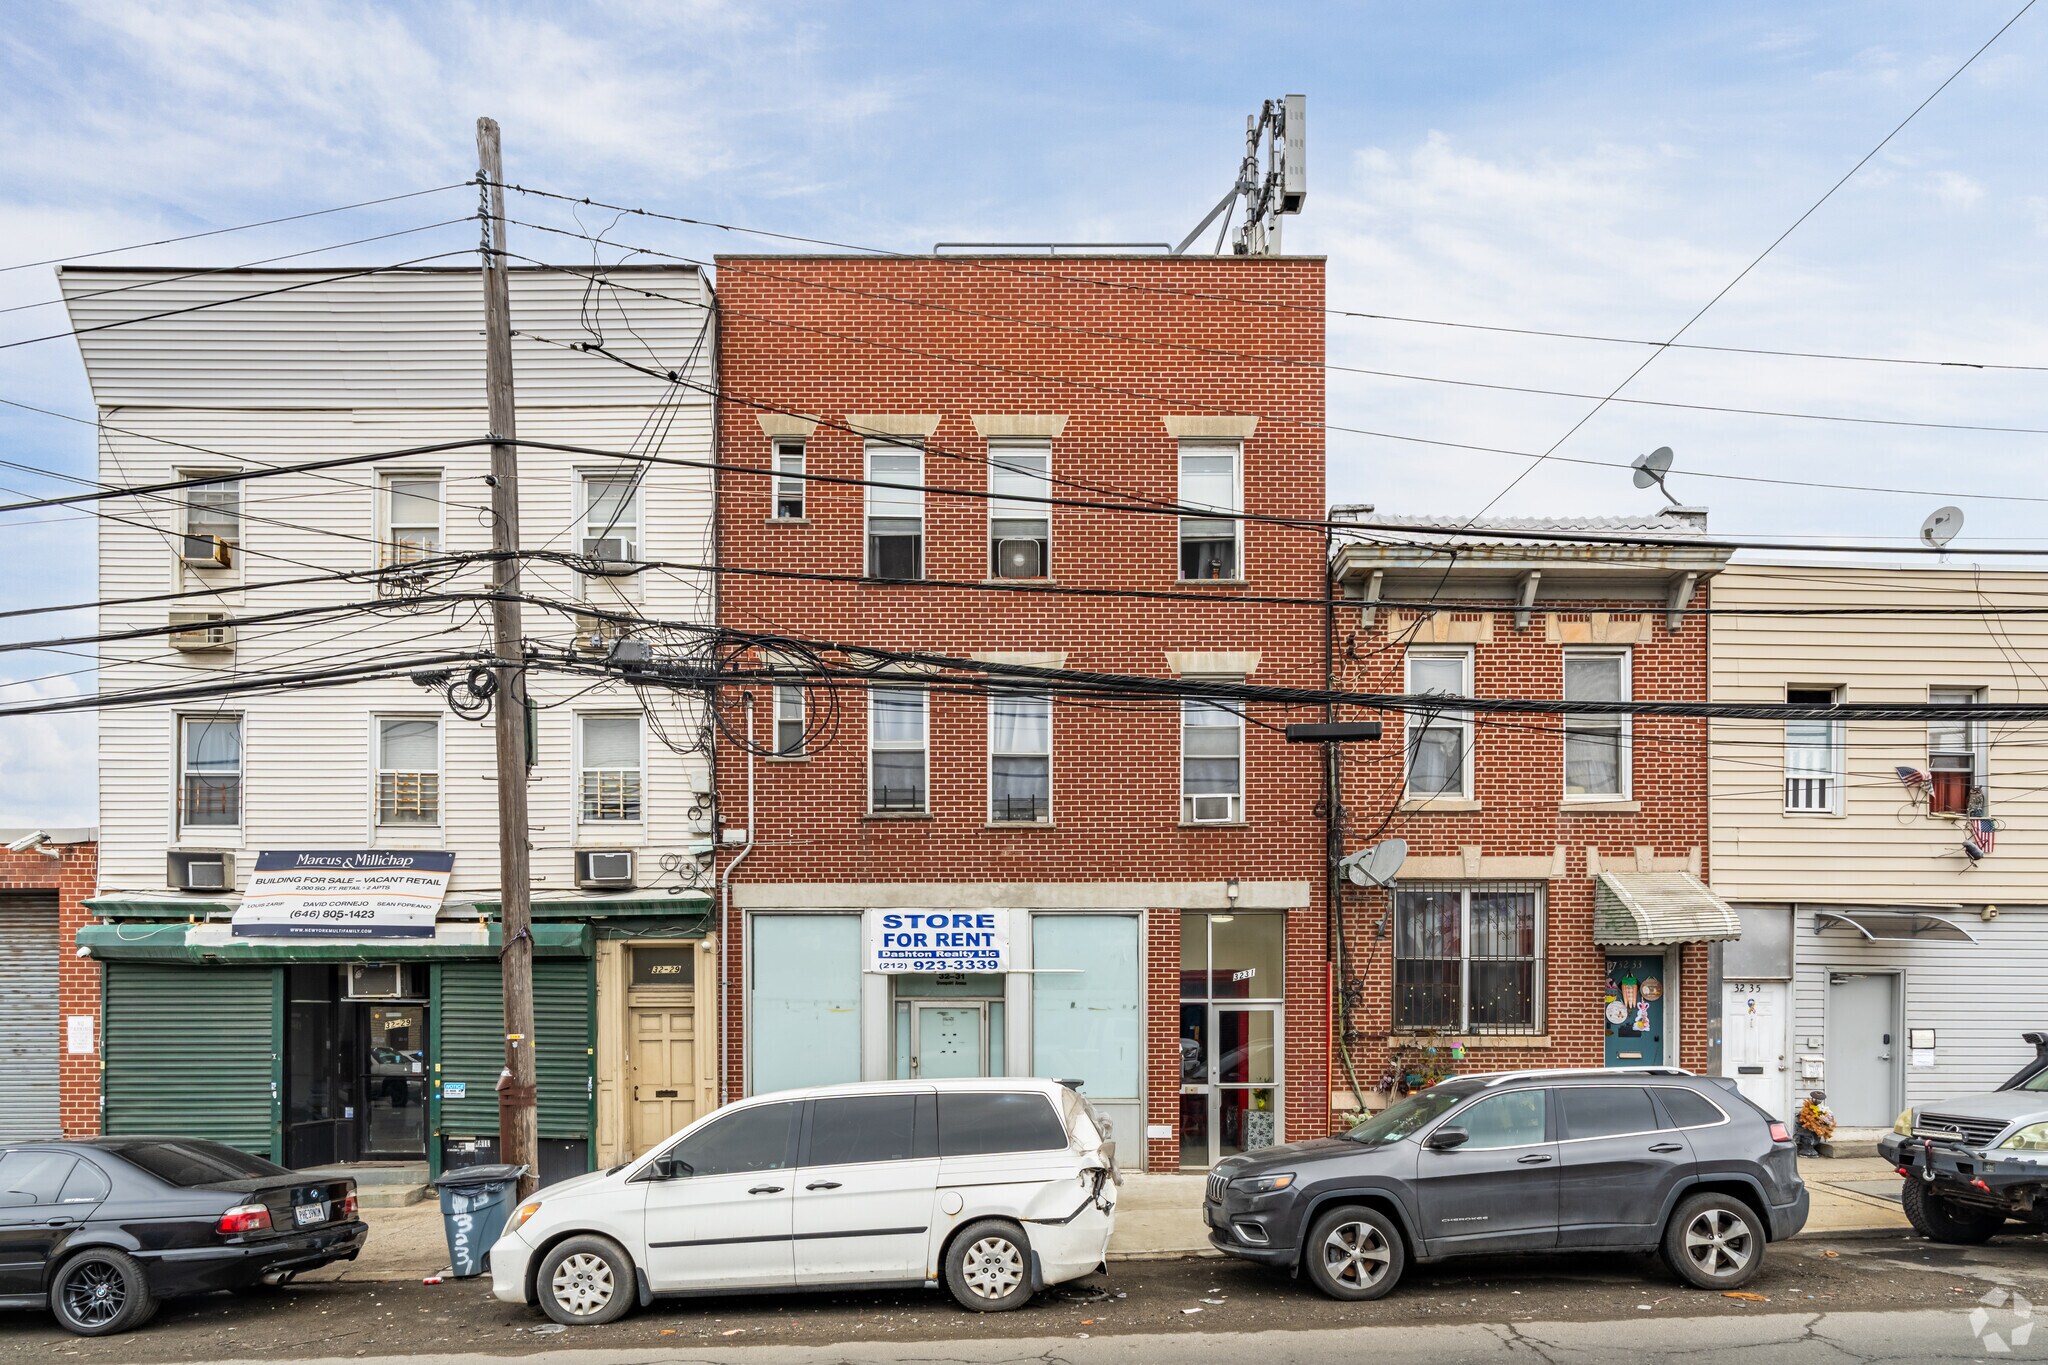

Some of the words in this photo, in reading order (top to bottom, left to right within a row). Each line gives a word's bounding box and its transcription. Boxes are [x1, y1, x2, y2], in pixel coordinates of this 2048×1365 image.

[296, 854, 342, 866] Marcus
[342, 857, 355, 869] &
[355, 853, 414, 868] Millichap
[255, 876, 302, 885] BUILDING
[303, 876, 326, 884] FOR
[364, 876, 405, 884] VACANT
[405, 877, 442, 886] RETAIL
[289, 910, 320, 920] (646)
[322, 910, 375, 919] 805-1423
[882, 914, 995, 929] STORE
[883, 933, 928, 947] FOR
[935, 932, 996, 947] RENT
[882, 950, 932, 958] Dashton
[935, 950, 975, 959] Realty
[879, 962, 908, 970] (212)
[913, 960, 998, 970] 923-3339
[1233, 970, 1253, 980] 3231
[386, 1020, 410, 1028] 32-29
[1441, 1215, 1489, 1223] CHEROKEE
